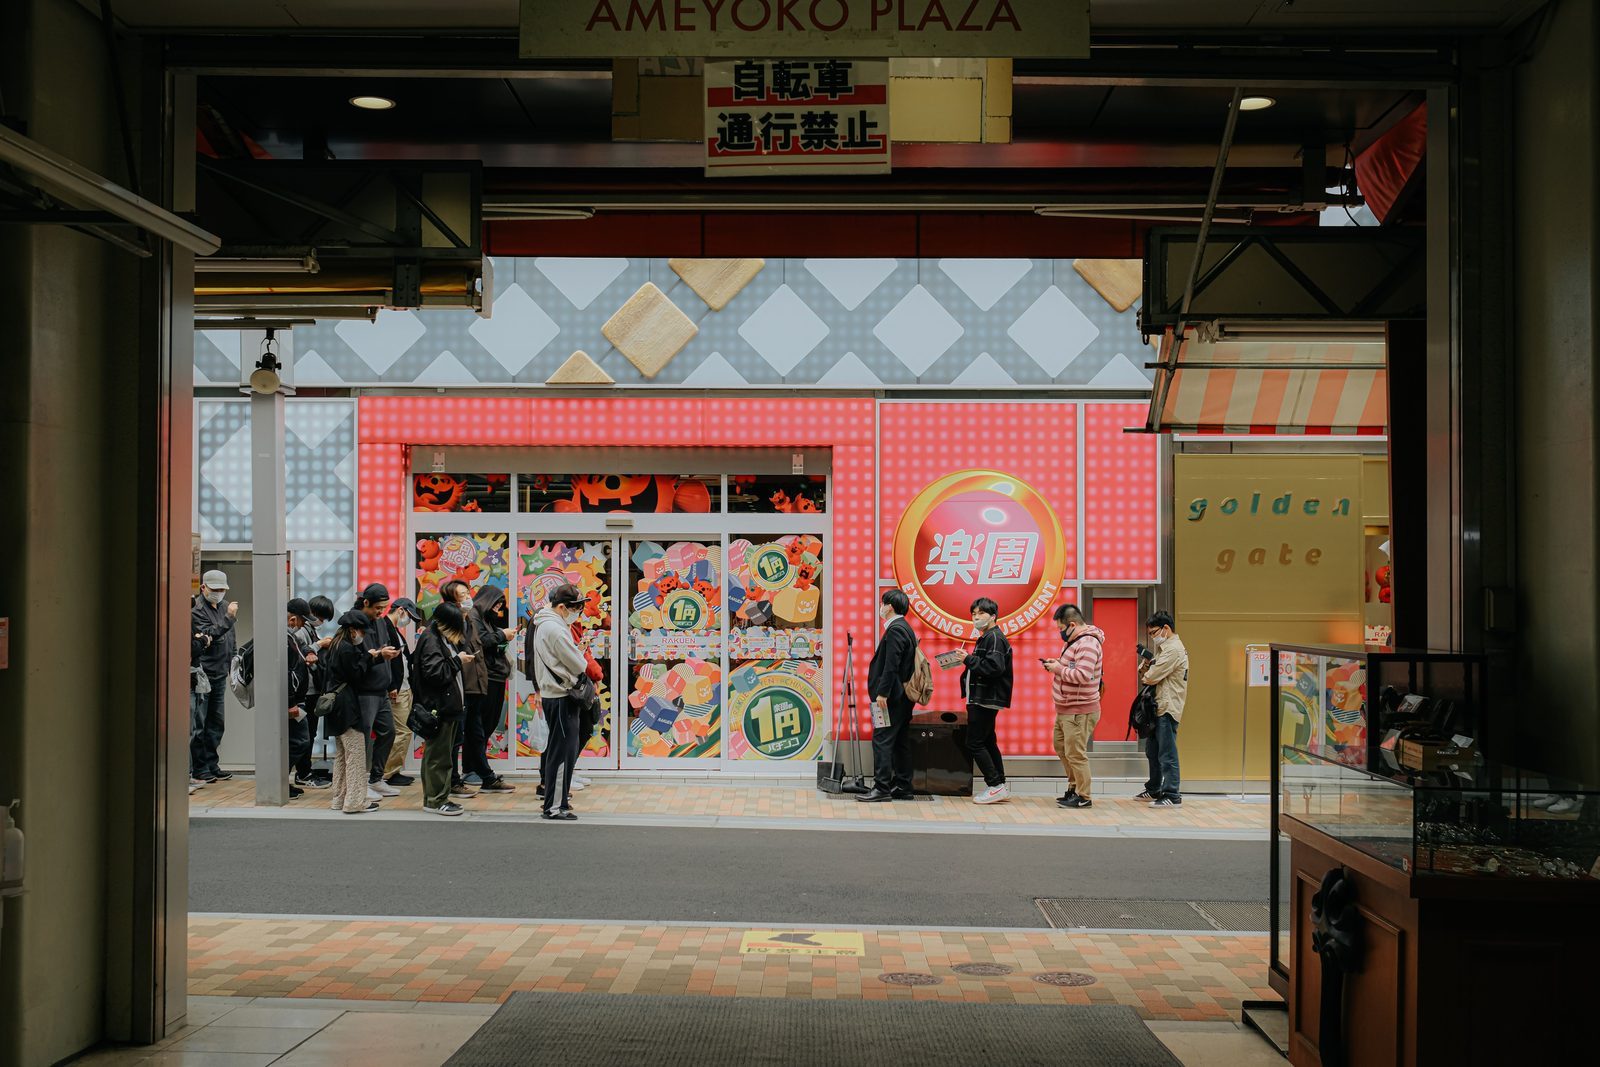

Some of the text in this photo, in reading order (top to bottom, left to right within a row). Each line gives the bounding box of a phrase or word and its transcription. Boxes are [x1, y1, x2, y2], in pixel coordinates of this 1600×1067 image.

[585, 0, 1022, 31] AMEYOKO PLAZA
[734, 60, 852, 100] 自転車
[717, 110, 881, 151] 通行禁止
[1187, 491, 1351, 522] golden
[922, 528, 1039, 585] 楽園
[1216, 542, 1322, 573] gate
[901, 580, 1058, 640] EXCITING AUSEMENT
[750, 695, 801, 744] 1円
